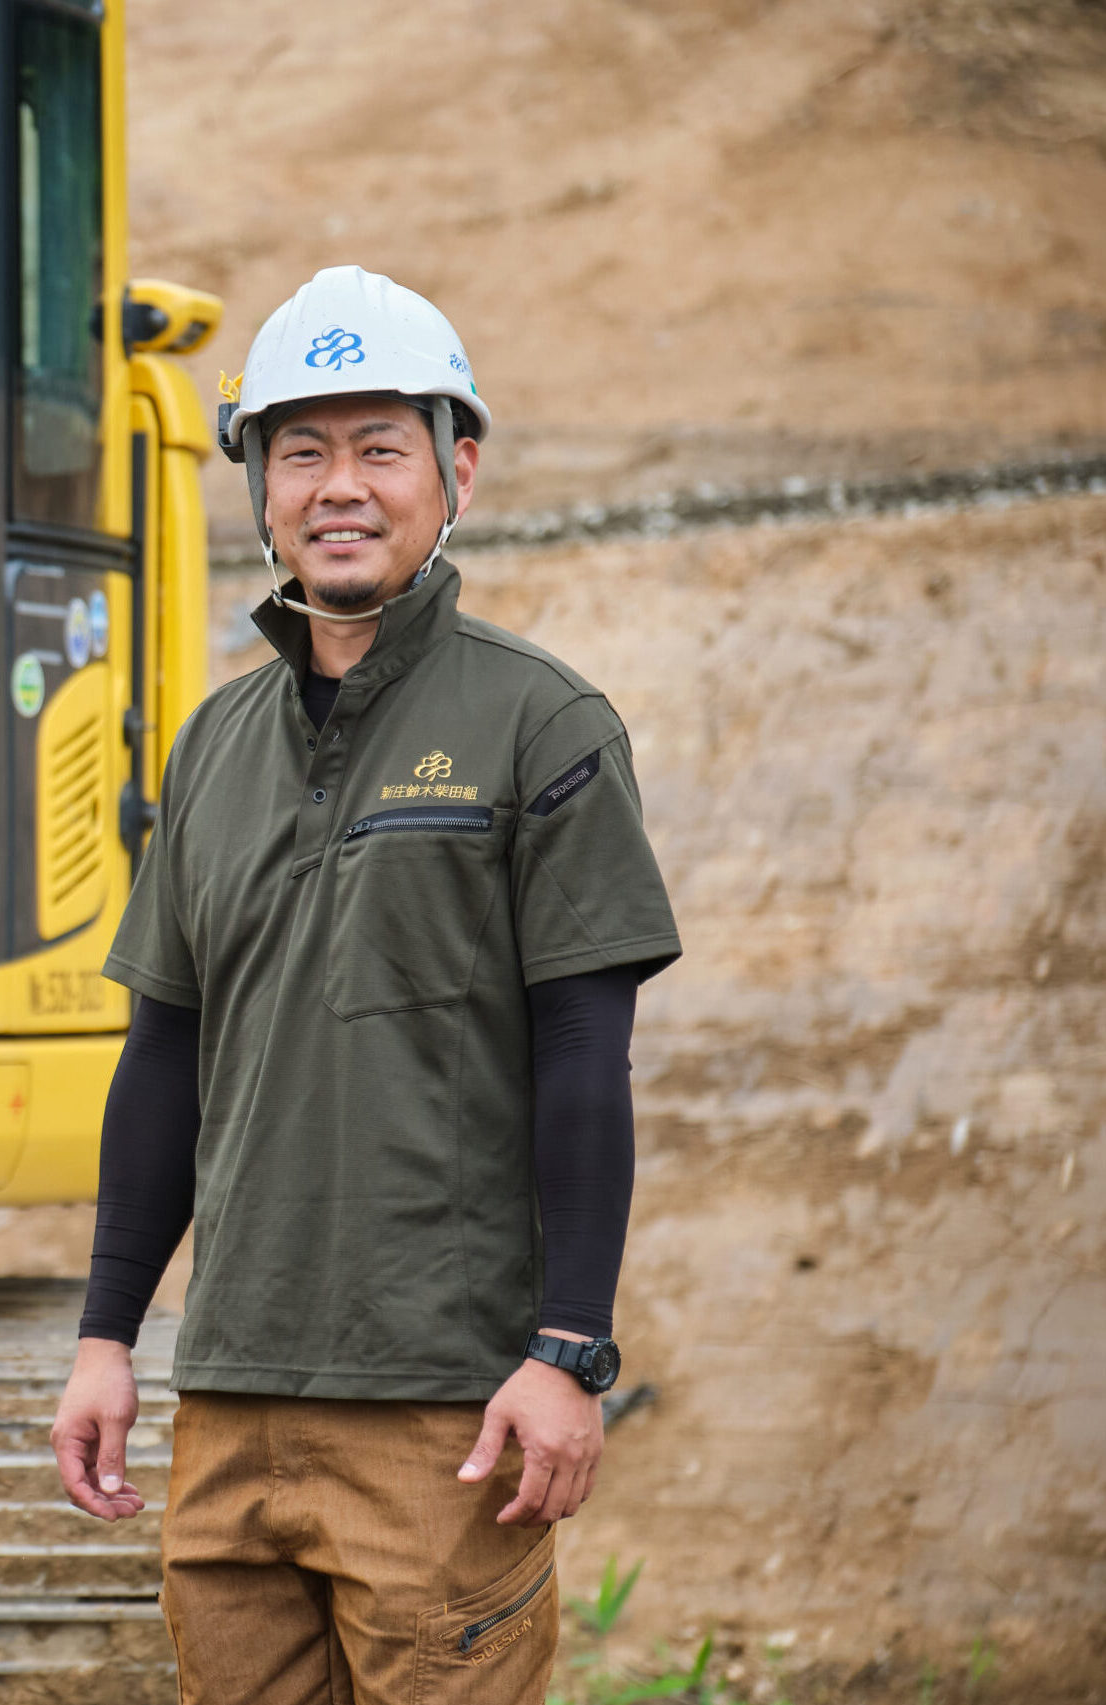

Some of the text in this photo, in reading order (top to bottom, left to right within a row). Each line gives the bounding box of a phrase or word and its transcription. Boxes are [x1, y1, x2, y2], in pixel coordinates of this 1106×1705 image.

[380, 784, 479, 801] 新庄鈴木柴田組
